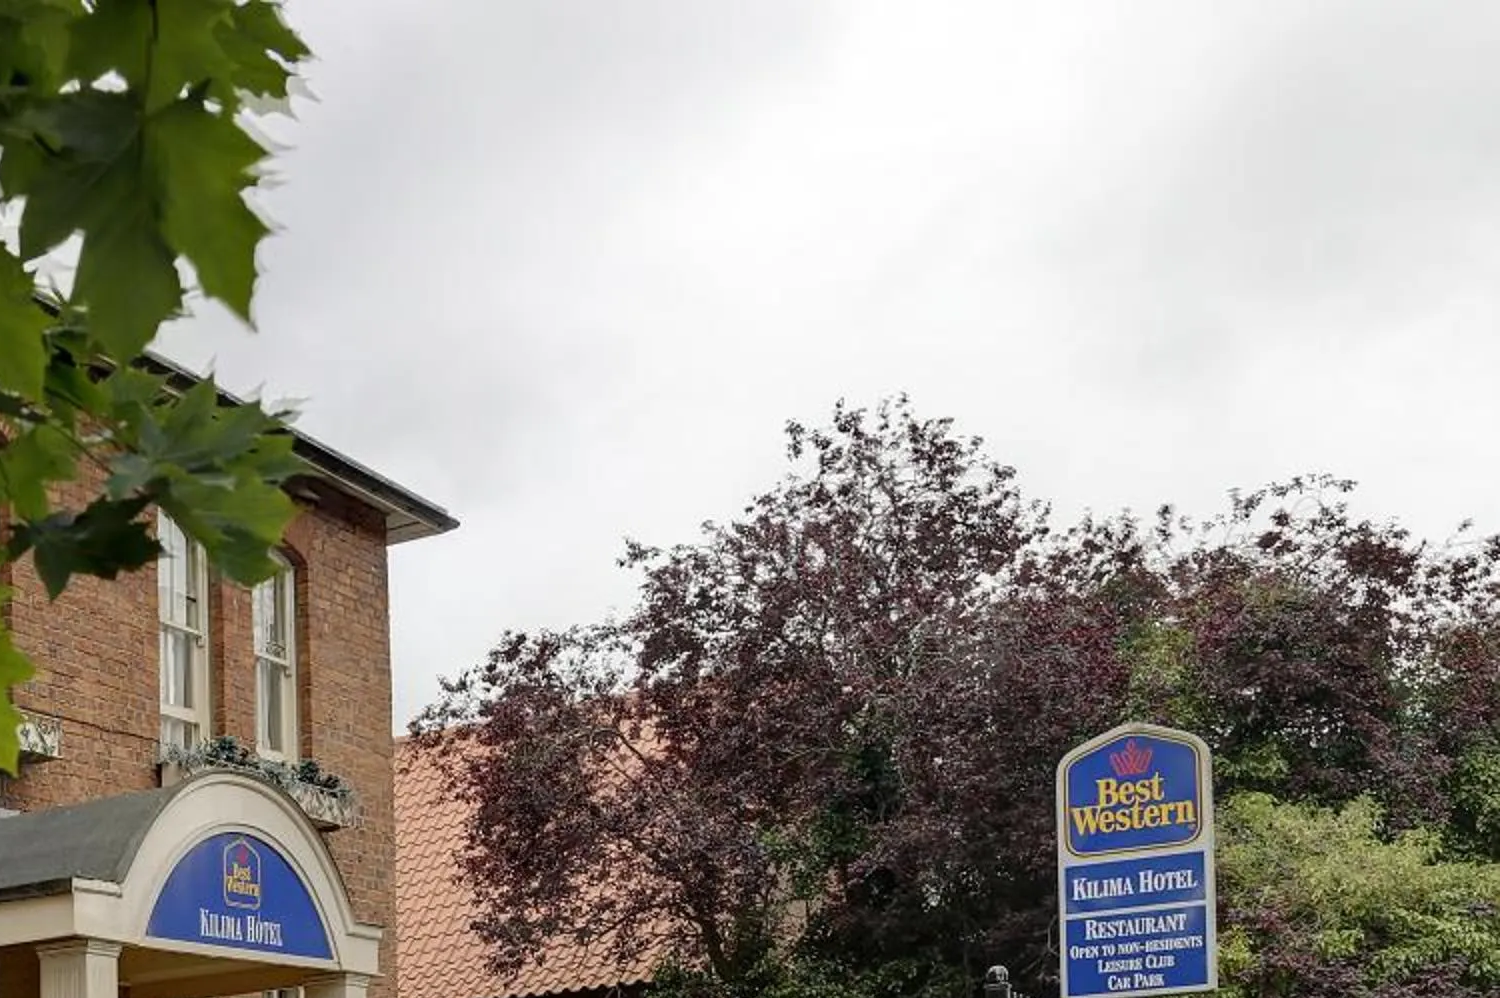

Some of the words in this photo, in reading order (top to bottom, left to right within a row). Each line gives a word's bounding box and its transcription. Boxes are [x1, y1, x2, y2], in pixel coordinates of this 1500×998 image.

[1096, 771, 1165, 807] Best
[1070, 799, 1196, 836] Western
[232, 862, 251, 881] Best
[227, 875, 260, 897] Western
[1073, 877, 1134, 901] KILIMA
[1139, 869, 1198, 893] HOTEL
[200, 907, 243, 941] KILIMA
[247, 915, 283, 946] HOTEL
[1085, 913, 1187, 941] RESTAURANT
[1070, 945, 1099, 960] OPEN
[1101, 944, 1116, 957] TO
[1097, 957, 1143, 974] LEISURE
[1145, 954, 1176, 970] CLUB
[1108, 975, 1131, 991] CAR
[1133, 972, 1165, 988] PARK
